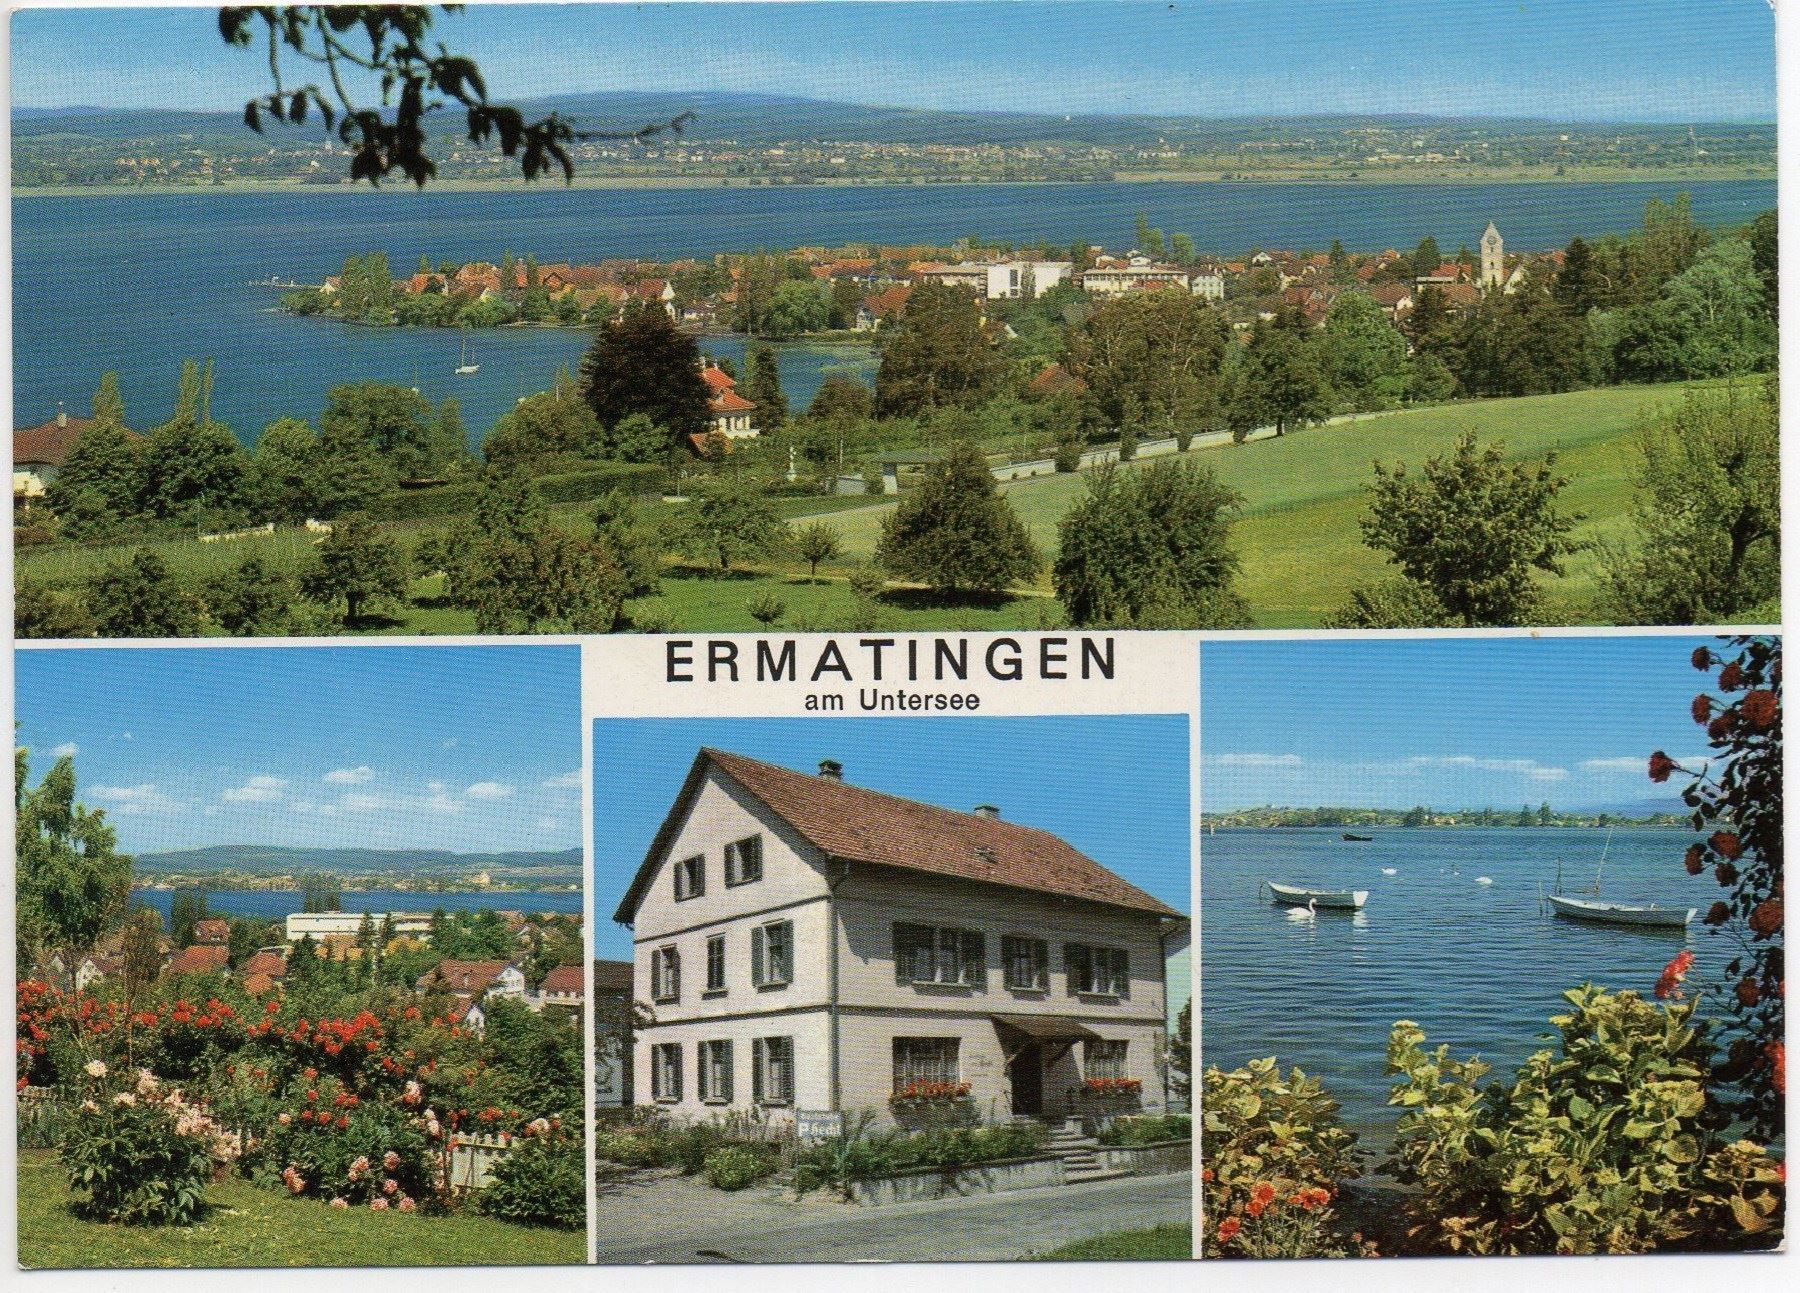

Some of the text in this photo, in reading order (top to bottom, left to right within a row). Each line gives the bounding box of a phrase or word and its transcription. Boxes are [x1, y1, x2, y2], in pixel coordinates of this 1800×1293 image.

[666, 638, 1115, 682] ERMATINGEN
[804, 688, 980, 711] am Untersee
